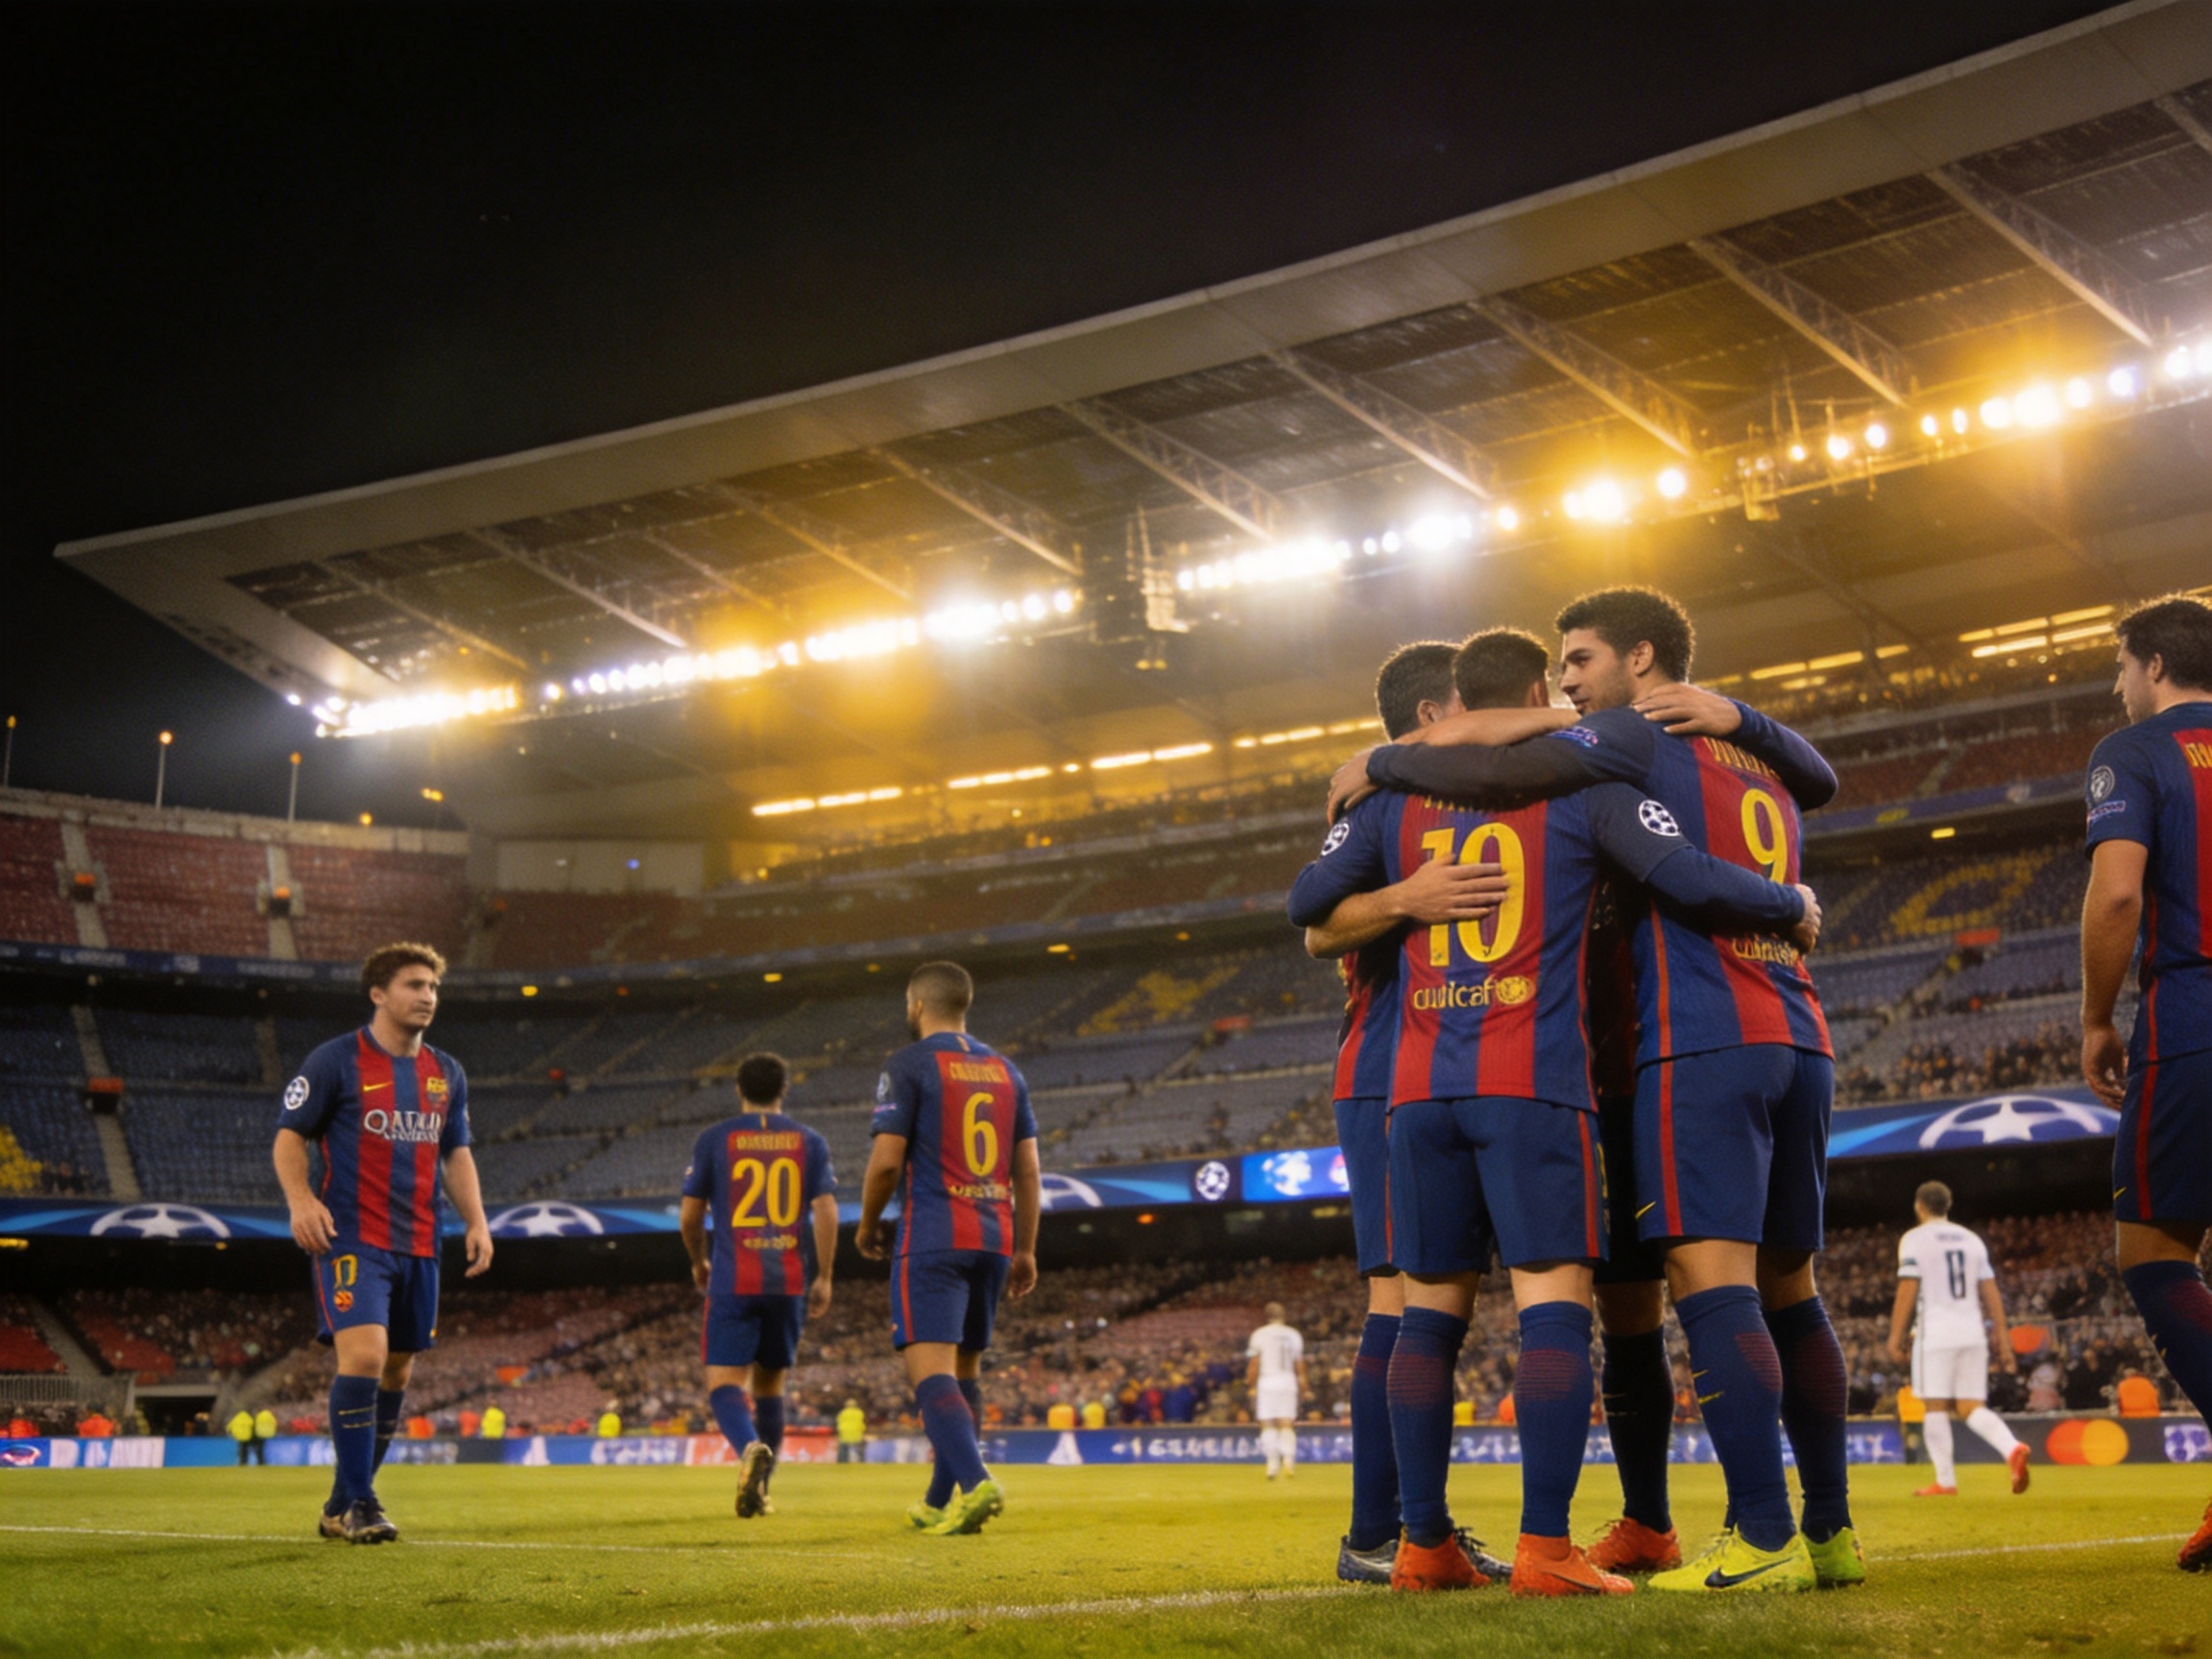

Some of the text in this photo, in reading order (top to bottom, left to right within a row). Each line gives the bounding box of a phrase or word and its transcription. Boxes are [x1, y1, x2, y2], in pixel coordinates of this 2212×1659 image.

[1742, 788, 1788, 884] 9
[1421, 822, 1526, 967] 10
[963, 1092, 998, 1177] 6
[732, 1157, 802, 1228] 20
